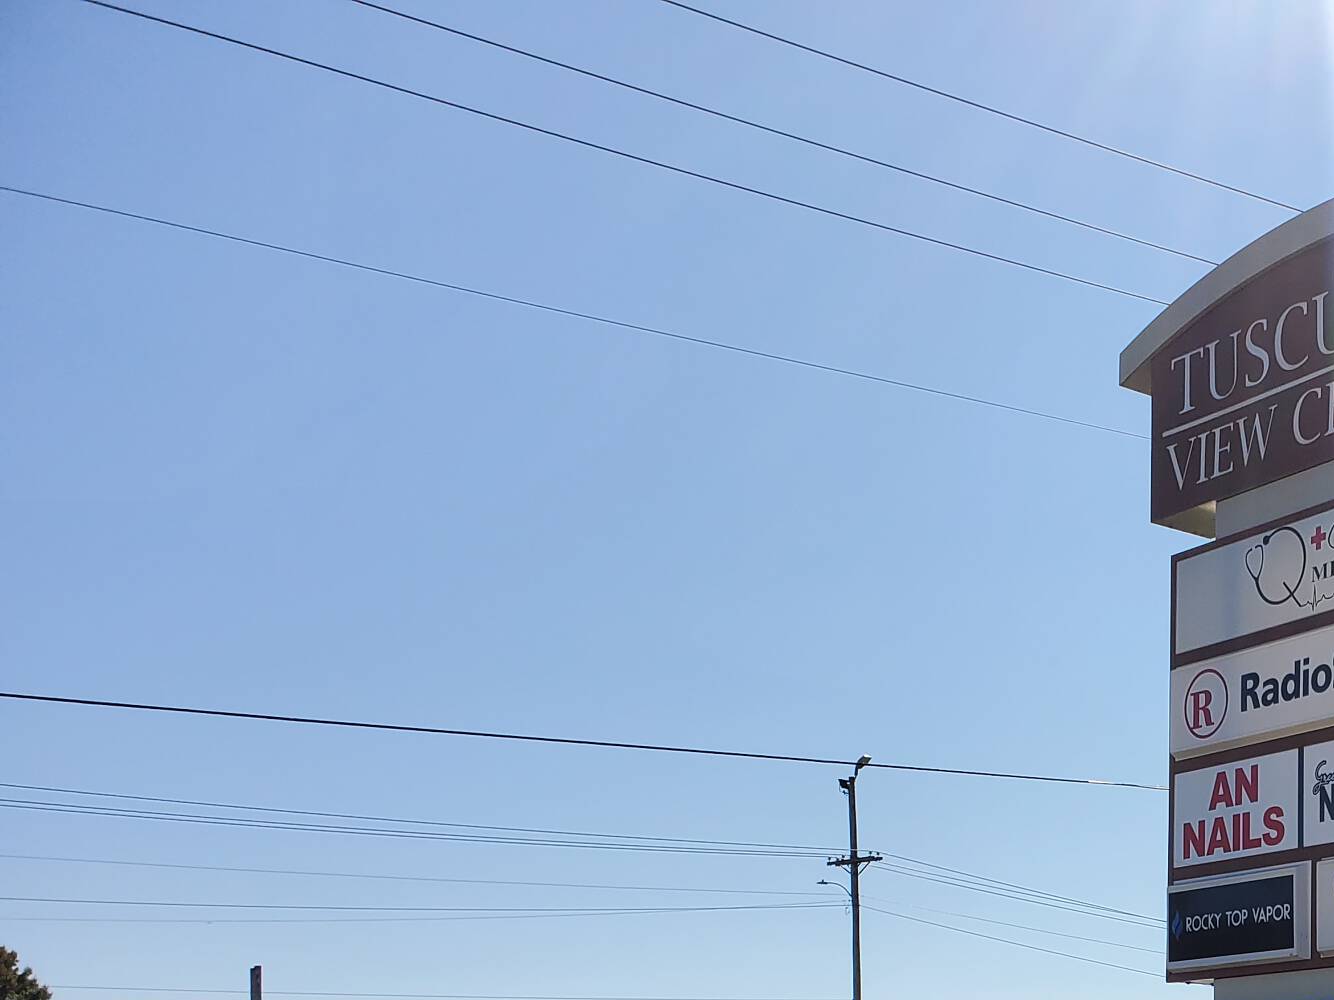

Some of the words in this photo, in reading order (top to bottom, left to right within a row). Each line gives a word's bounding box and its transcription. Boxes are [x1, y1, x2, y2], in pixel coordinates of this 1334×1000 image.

[1166, 404, 1278, 492] VIEW
[1189, 689, 1215, 730] R
[1208, 764, 1259, 811] AN
[1183, 806, 1286, 860] NAILS
[1185, 912, 1222, 933] ROCKY
[1225, 909, 1249, 928] TOP
[1251, 903, 1291, 924] VAPOR
